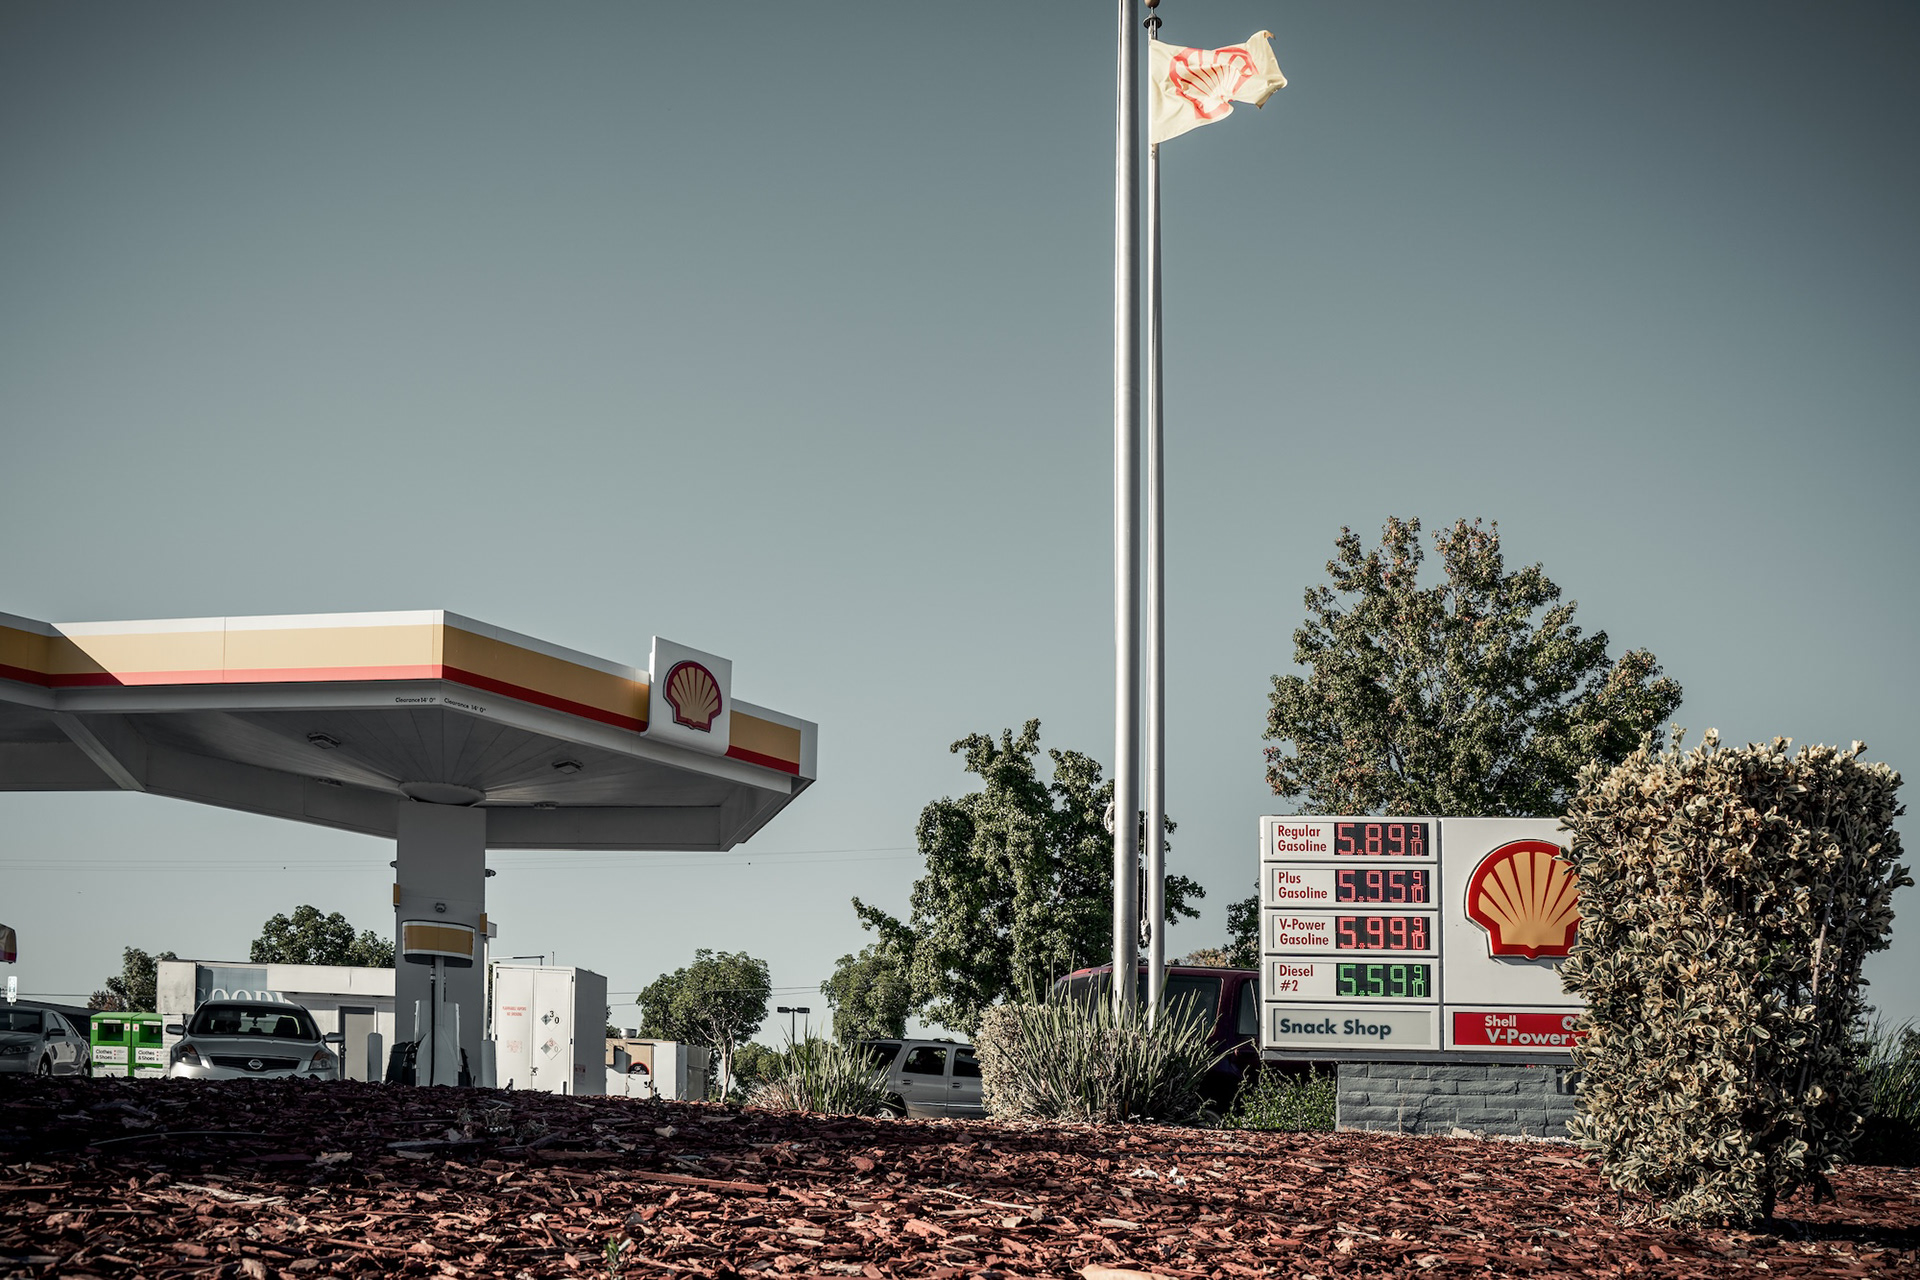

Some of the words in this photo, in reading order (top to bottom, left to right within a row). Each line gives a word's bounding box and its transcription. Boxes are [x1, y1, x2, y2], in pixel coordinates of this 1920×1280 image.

[444, 697, 469, 709] Clearance
[1277, 824, 1321, 840] Regular
[1277, 840, 1327, 852] Gasoline
[1337, 823, 1406, 856] 5.89
[1278, 872, 1301, 884] Plus
[1278, 886, 1328, 899] Gasoline
[1338, 870, 1406, 902] 5.95
[1279, 918, 1326, 931] V-Power
[1279, 933, 1329, 945] Gasoline
[1339, 917, 1407, 949] 5.99
[1279, 964, 1314, 977] Diesel
[1279, 979, 1299, 992] #2
[1339, 964, 1407, 997] 5.59
[1484, 1014, 1517, 1027] Shell
[1279, 1018, 1338, 1035] Snack
[1343, 1019, 1392, 1040] Shop
